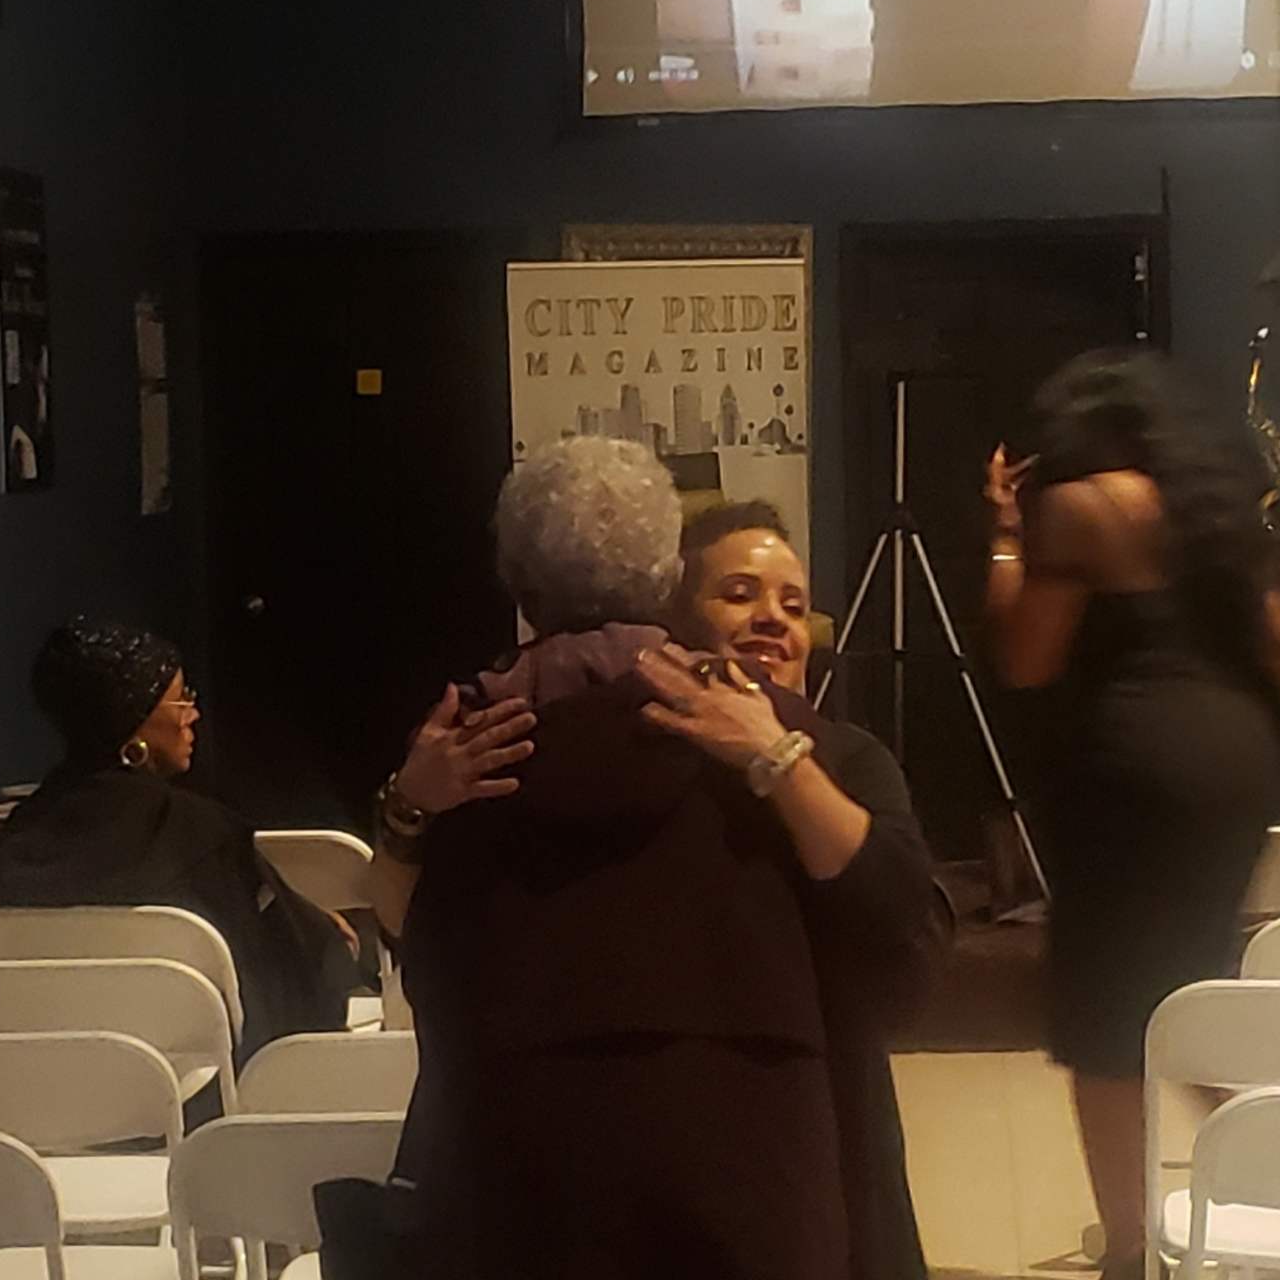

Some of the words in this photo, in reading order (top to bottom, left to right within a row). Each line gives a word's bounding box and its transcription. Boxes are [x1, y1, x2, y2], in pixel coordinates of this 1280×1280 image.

[524, 297, 634, 338] CITY
[661, 294, 798, 333] PRIDE
[525, 346, 800, 377] MAGAZINE
